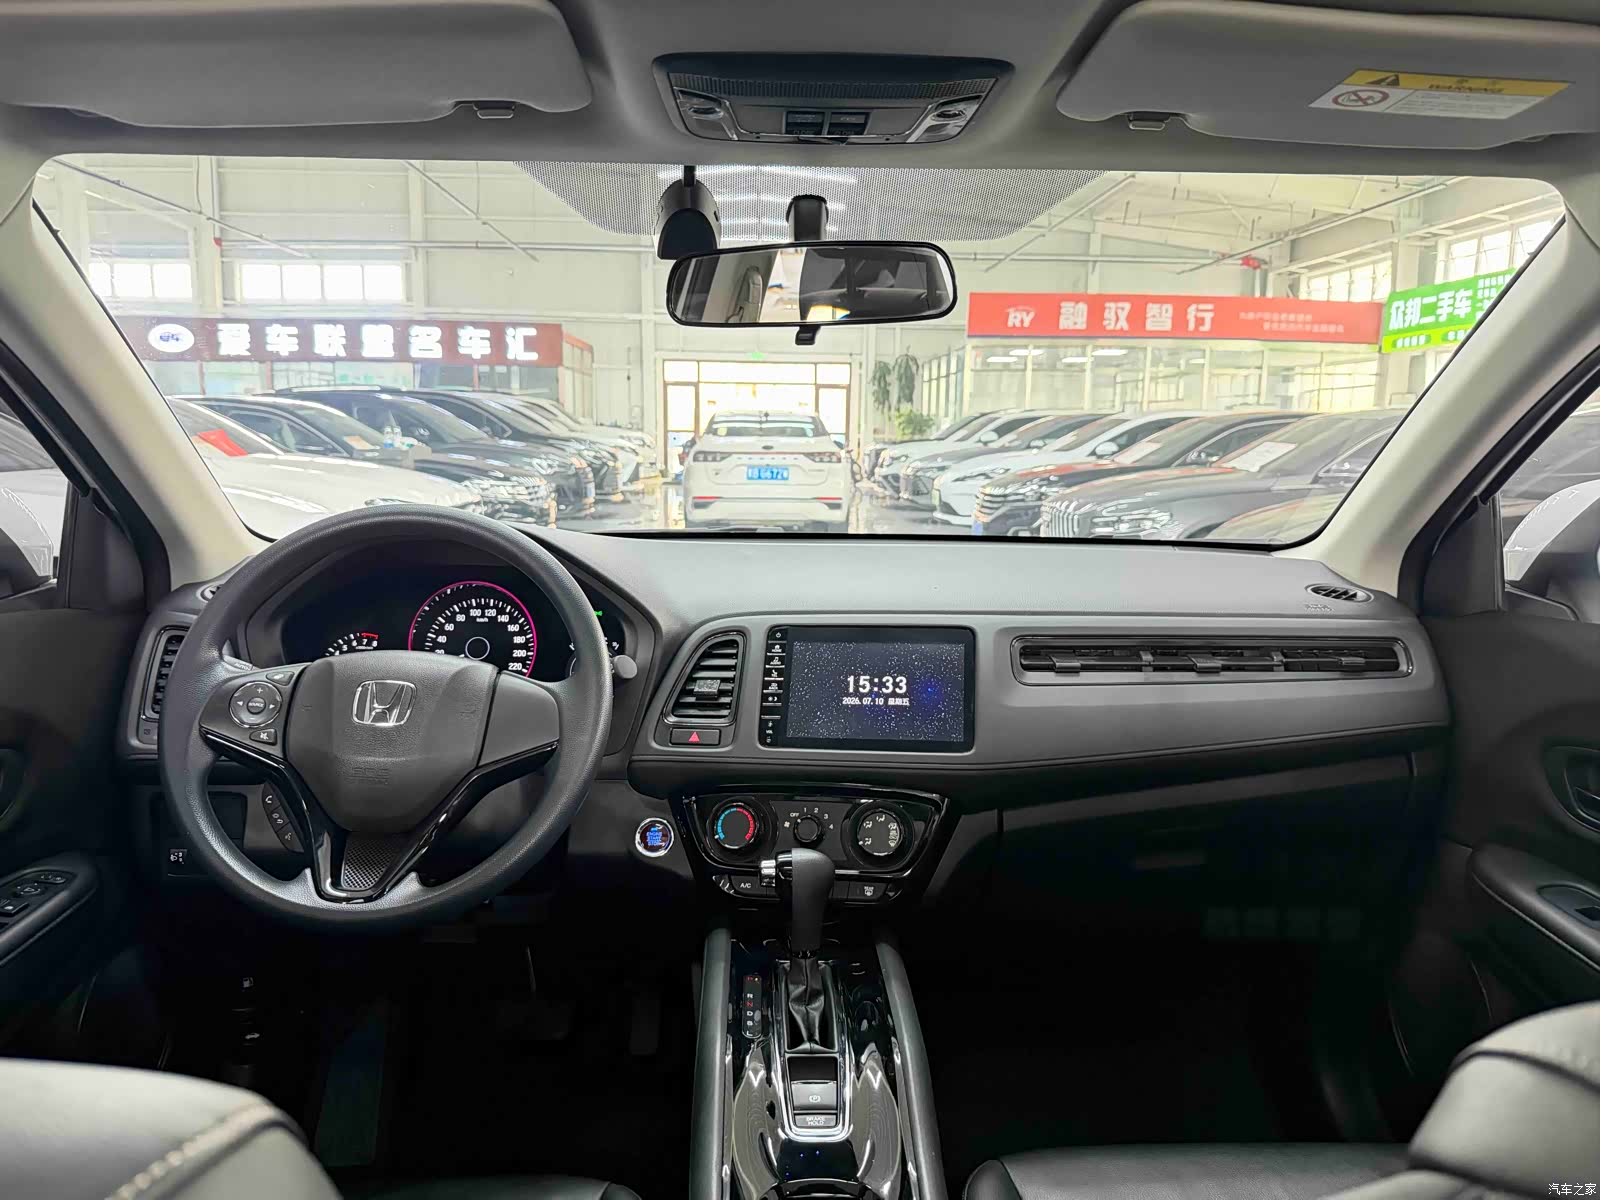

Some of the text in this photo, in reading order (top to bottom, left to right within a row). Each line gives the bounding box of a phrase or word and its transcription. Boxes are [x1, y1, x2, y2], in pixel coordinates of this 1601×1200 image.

[1006, 309, 1036, 328] RY
[1058, 301, 1216, 332] 融驭智行
[217, 323, 539, 361] 爱车联盟名车汇
[469, 608, 482, 617] 100
[484, 608, 497, 617] 120
[455, 614, 466, 622] 80
[497, 614, 510, 623] 140
[444, 623, 455, 631] 60
[507, 624, 520, 632] 160
[436, 635, 447, 643] 40
[513, 636, 526, 644] 180
[512, 649, 527, 657] 200
[508, 662, 523, 671] 220
[847, 674, 908, 694] 15:33
[841, 696, 885, 705] 2026.07.10
